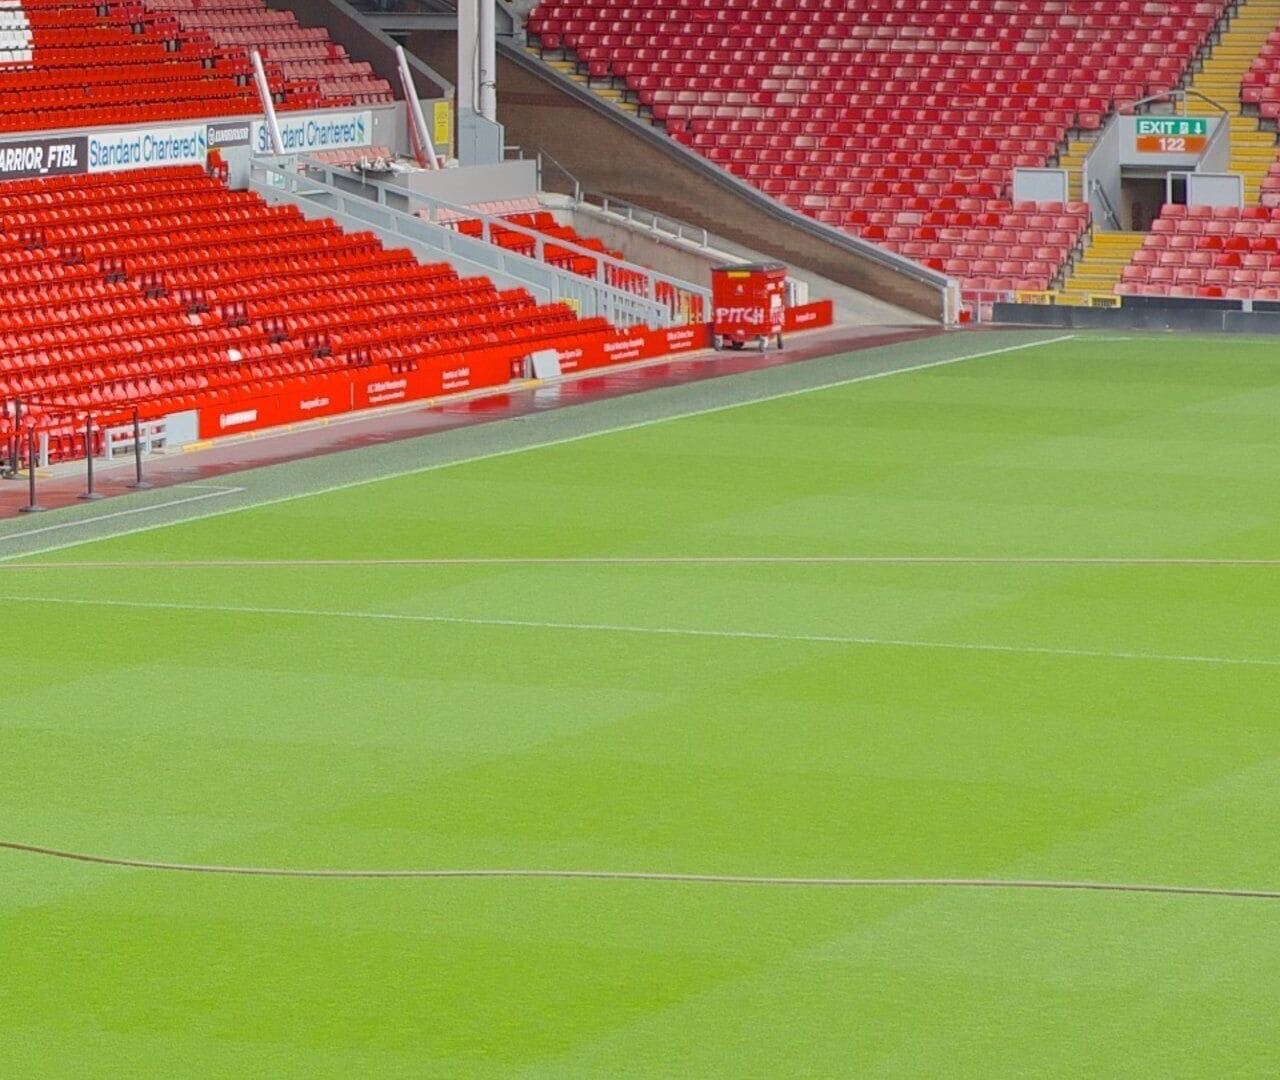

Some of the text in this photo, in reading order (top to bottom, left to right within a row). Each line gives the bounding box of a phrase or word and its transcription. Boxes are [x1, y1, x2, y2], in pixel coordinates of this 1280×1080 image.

[307, 118, 356, 147] Chartered
[1140, 121, 1175, 134] EXIT
[90, 131, 196, 167] Standard Chartered
[1159, 137, 1186, 152] 122
[716, 308, 764, 324] PITCH
